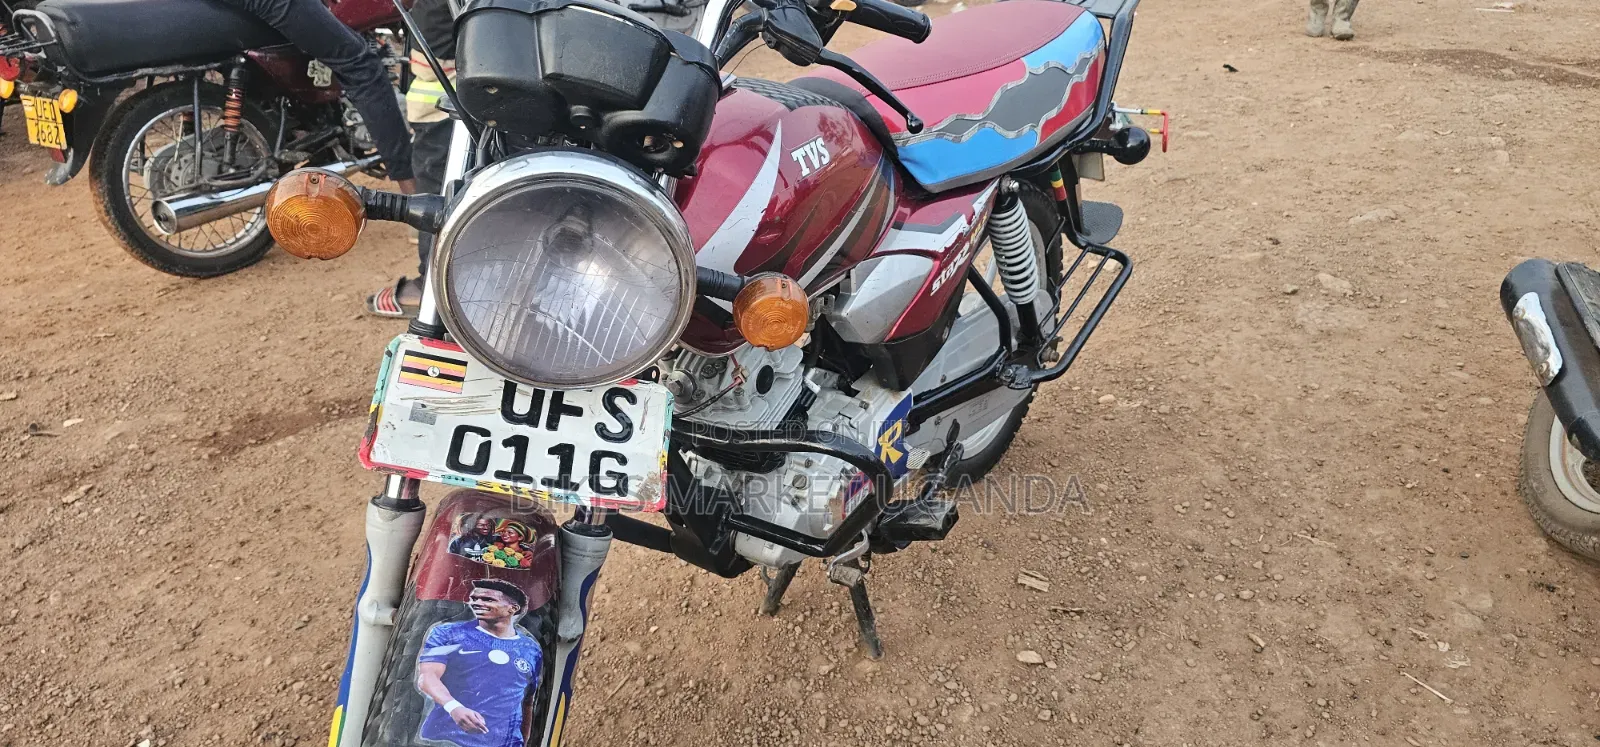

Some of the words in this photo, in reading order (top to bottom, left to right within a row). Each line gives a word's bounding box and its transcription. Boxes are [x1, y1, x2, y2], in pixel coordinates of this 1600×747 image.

[790, 136, 831, 177] TVS
[500, 379, 638, 444] UFS
[445, 424, 629, 498] 011G
